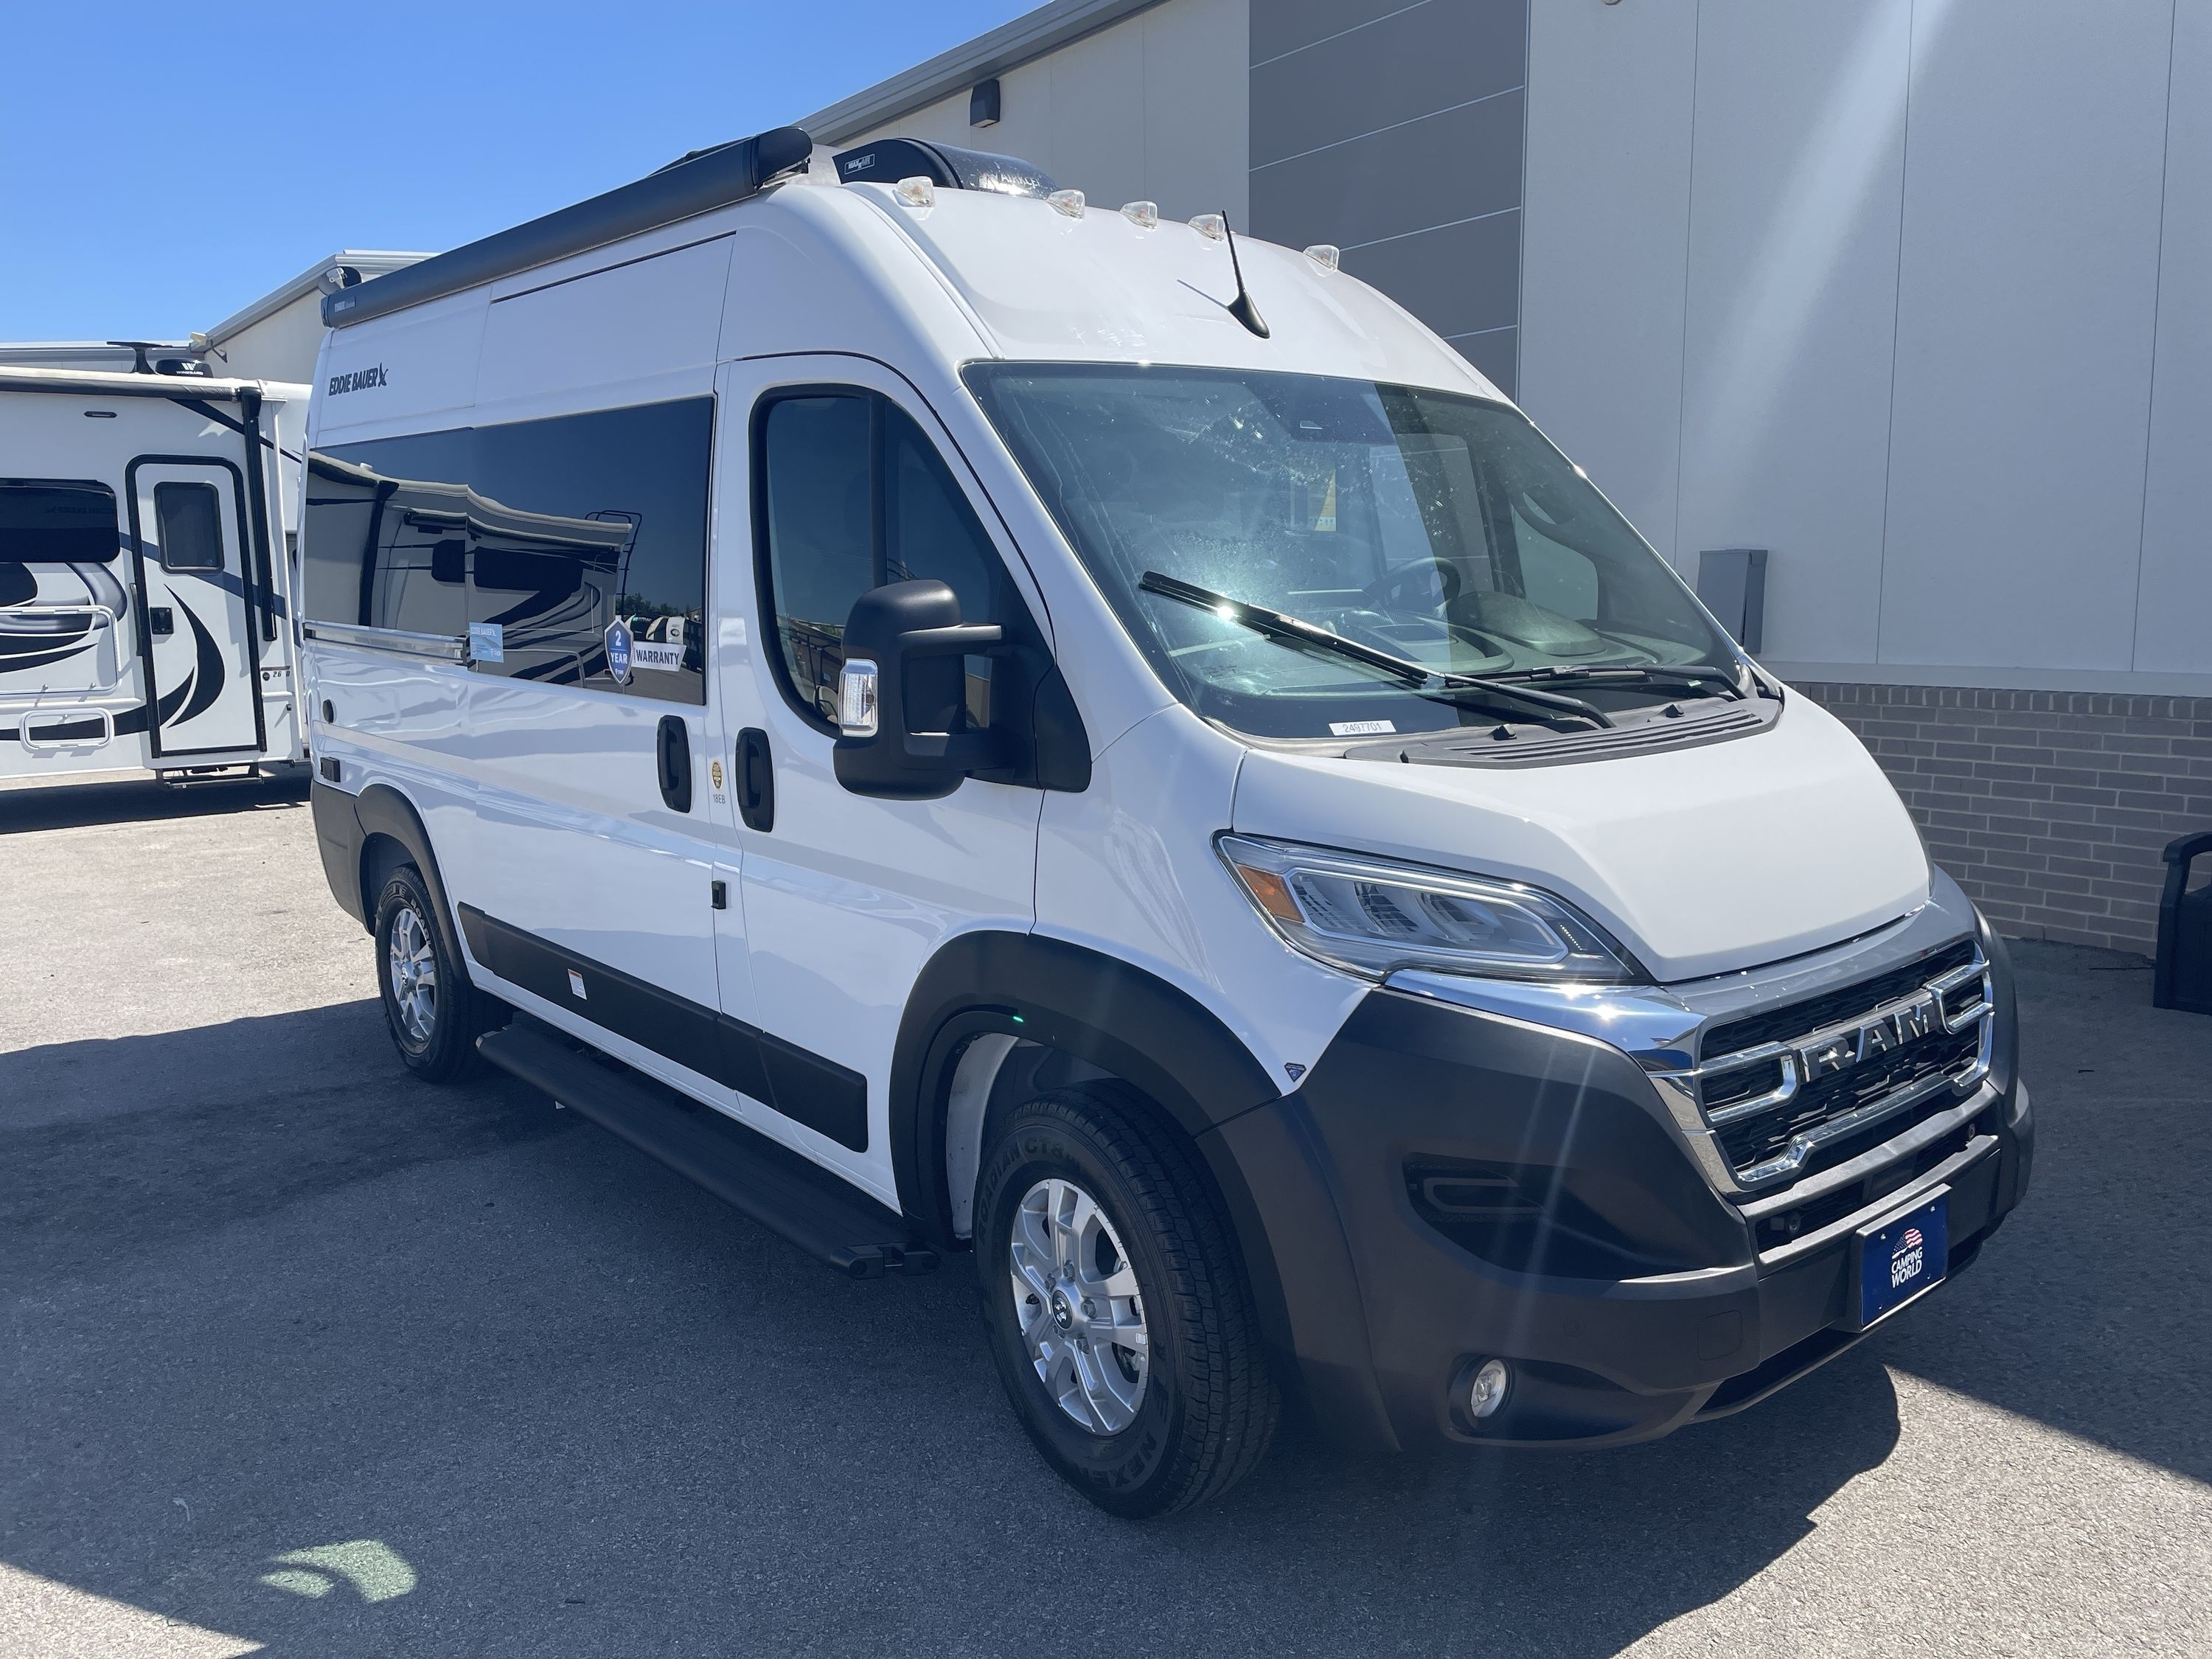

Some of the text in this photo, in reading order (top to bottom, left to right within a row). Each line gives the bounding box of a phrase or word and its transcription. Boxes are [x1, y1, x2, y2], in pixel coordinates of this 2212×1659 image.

[329, 367, 378, 396] EDDIE BAUER
[615, 630, 622, 647] 2
[610, 652, 628, 664] YEAR
[636, 650, 679, 665] WARRANTY
[1343, 722, 1382, 733] 2497701
[713, 793, 726, 804] 18EB
[1800, 999, 1938, 1082] RAM
[1891, 1246, 1923, 1274] CAMPING
[1891, 1259, 1923, 1289] WORLD
